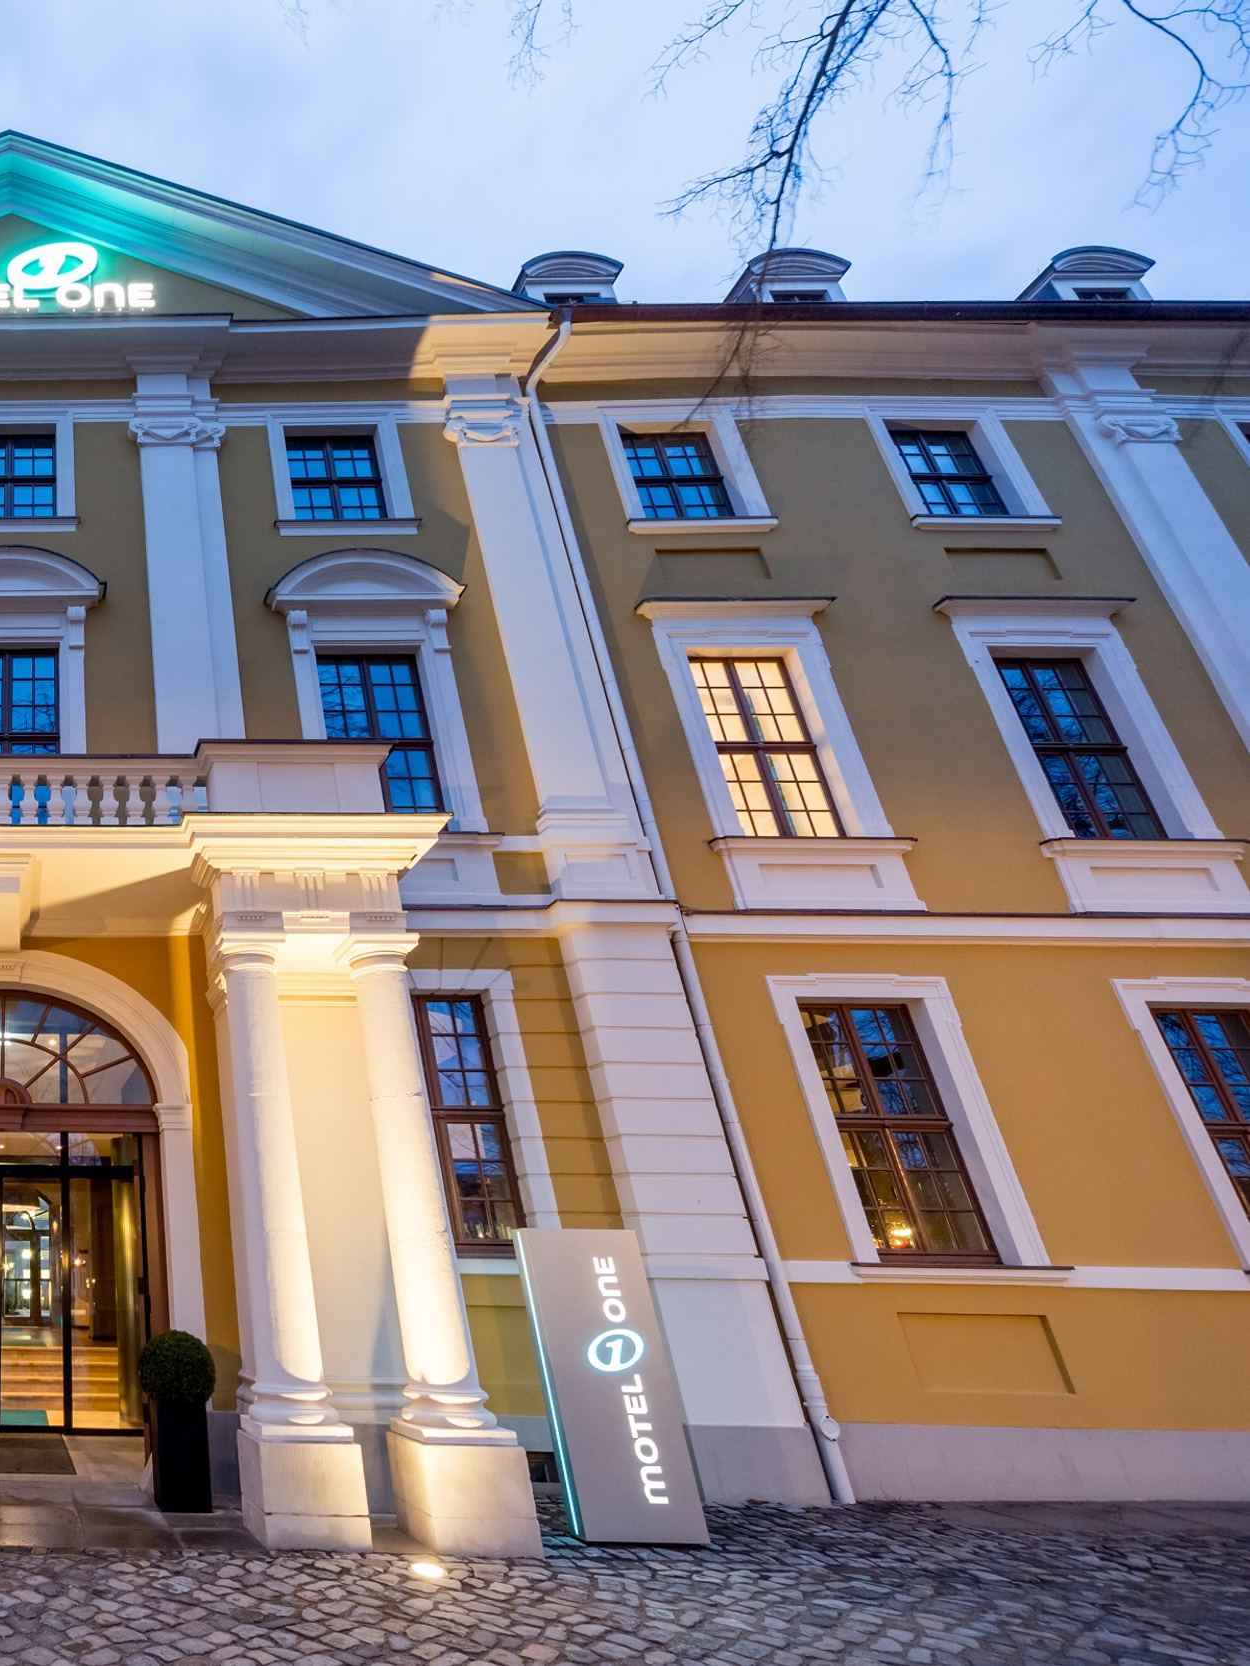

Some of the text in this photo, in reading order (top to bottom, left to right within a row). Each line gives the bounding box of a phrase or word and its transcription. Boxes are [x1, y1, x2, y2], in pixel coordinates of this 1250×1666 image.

[56, 283, 155, 309] ONE
[592, 1256, 626, 1322] ONE
[621, 1373, 670, 1505] MOTEL
